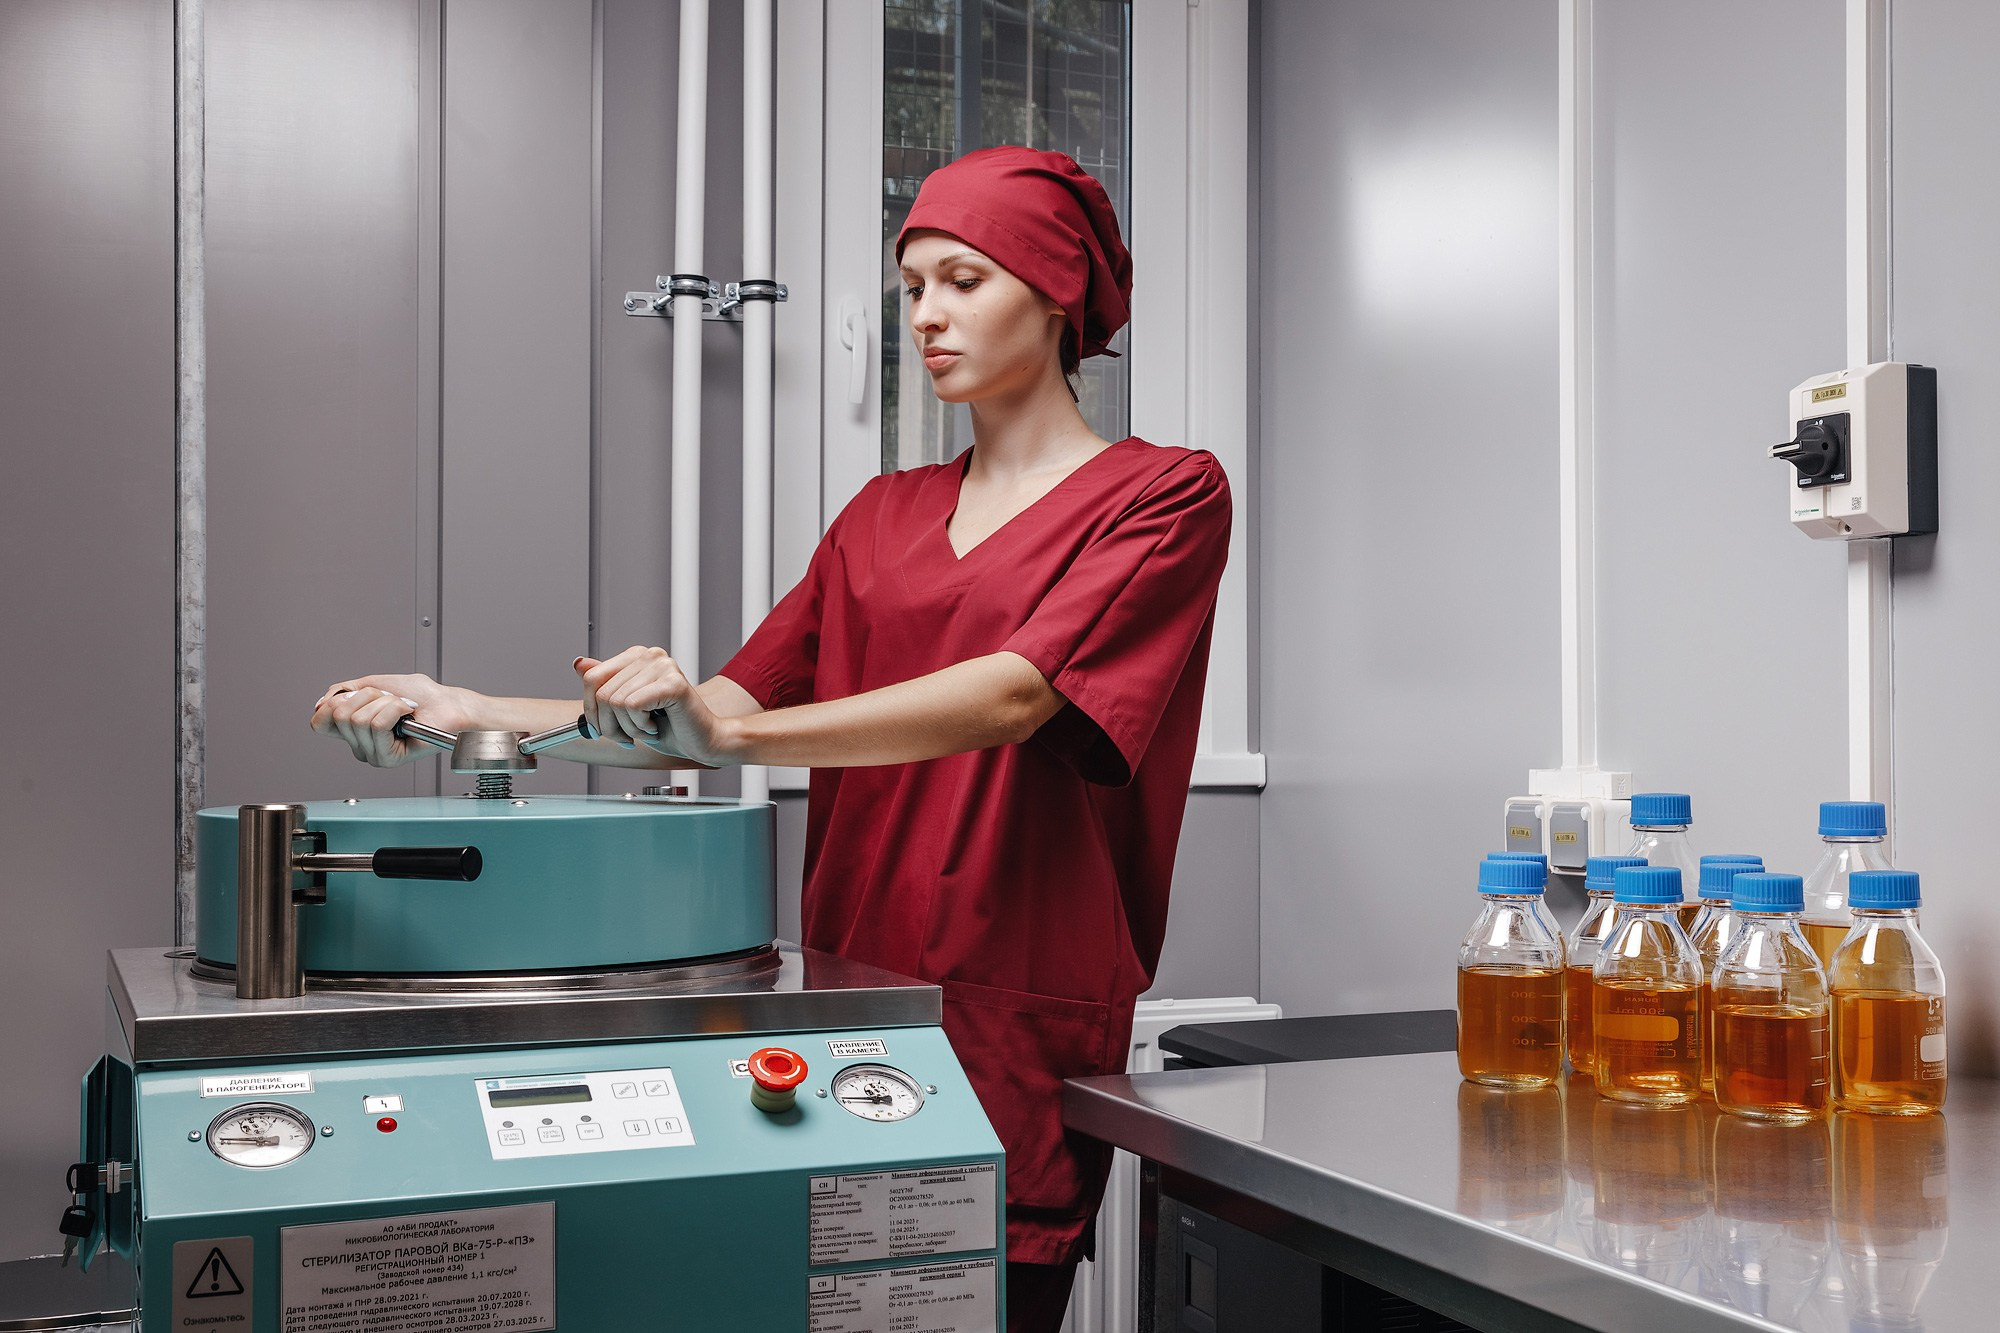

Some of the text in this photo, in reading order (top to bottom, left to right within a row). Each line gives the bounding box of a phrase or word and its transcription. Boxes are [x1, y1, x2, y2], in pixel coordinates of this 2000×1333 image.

[217, 1083, 306, 1092] ПАРОГЕНЕРАТОРЕ
[230, 1077, 282, 1085] ДАВЛЕНИЕ
[419, 1220, 457, 1230] ПРОДАКТ»
[345, 1224, 494, 1245] МИКРОБИОЛОГИЧЕСКАЯ ЛАБОРАТОРИЯ
[302, 1250, 391, 1267] СТЕРИЛИЗАТОР
[395, 1242, 448, 1257] ПАРОВОЙ
[356, 1255, 444, 1272] РЕГИСТРАЦИОННЫЙ
[448, 1253, 477, 1262] НОМЕР
[322, 1281, 386, 1295] Максимальное
[389, 1278, 424, 1289] рабочее
[427, 1274, 467, 1284] давление
[471, 1271, 483, 1279] 1,1
[378, 1269, 419, 1280] (Заводской
[422, 1268, 445, 1276] номер
[286, 1307, 305, 1315] Дата
[309, 1302, 343, 1312] монтажа
[374, 1294, 419, 1304] 28.09.2021
[286, 1317, 305, 1325] Дата
[309, 1311, 357, 1322] проведения
[361, 1302, 429, 1315] гидравлического
[432, 1298, 474, 1308] испытания
[478, 1291, 521, 1302] 20.07.2020
[183, 1314, 245, 1326] Ознакомьтесь
[309, 1320, 359, 1332] следующего
[362, 1312, 431, 1325] гидравлического
[434, 1307, 476, 1317] испытания
[480, 1300, 523, 1312] 19.07.2028
[406, 1320, 442, 1330] осмотров
[446, 1313, 490, 1324] 28.03.2023
[455, 1323, 491, 1333] осмотров
[494, 1316, 537, 1328] 27.03.2025
